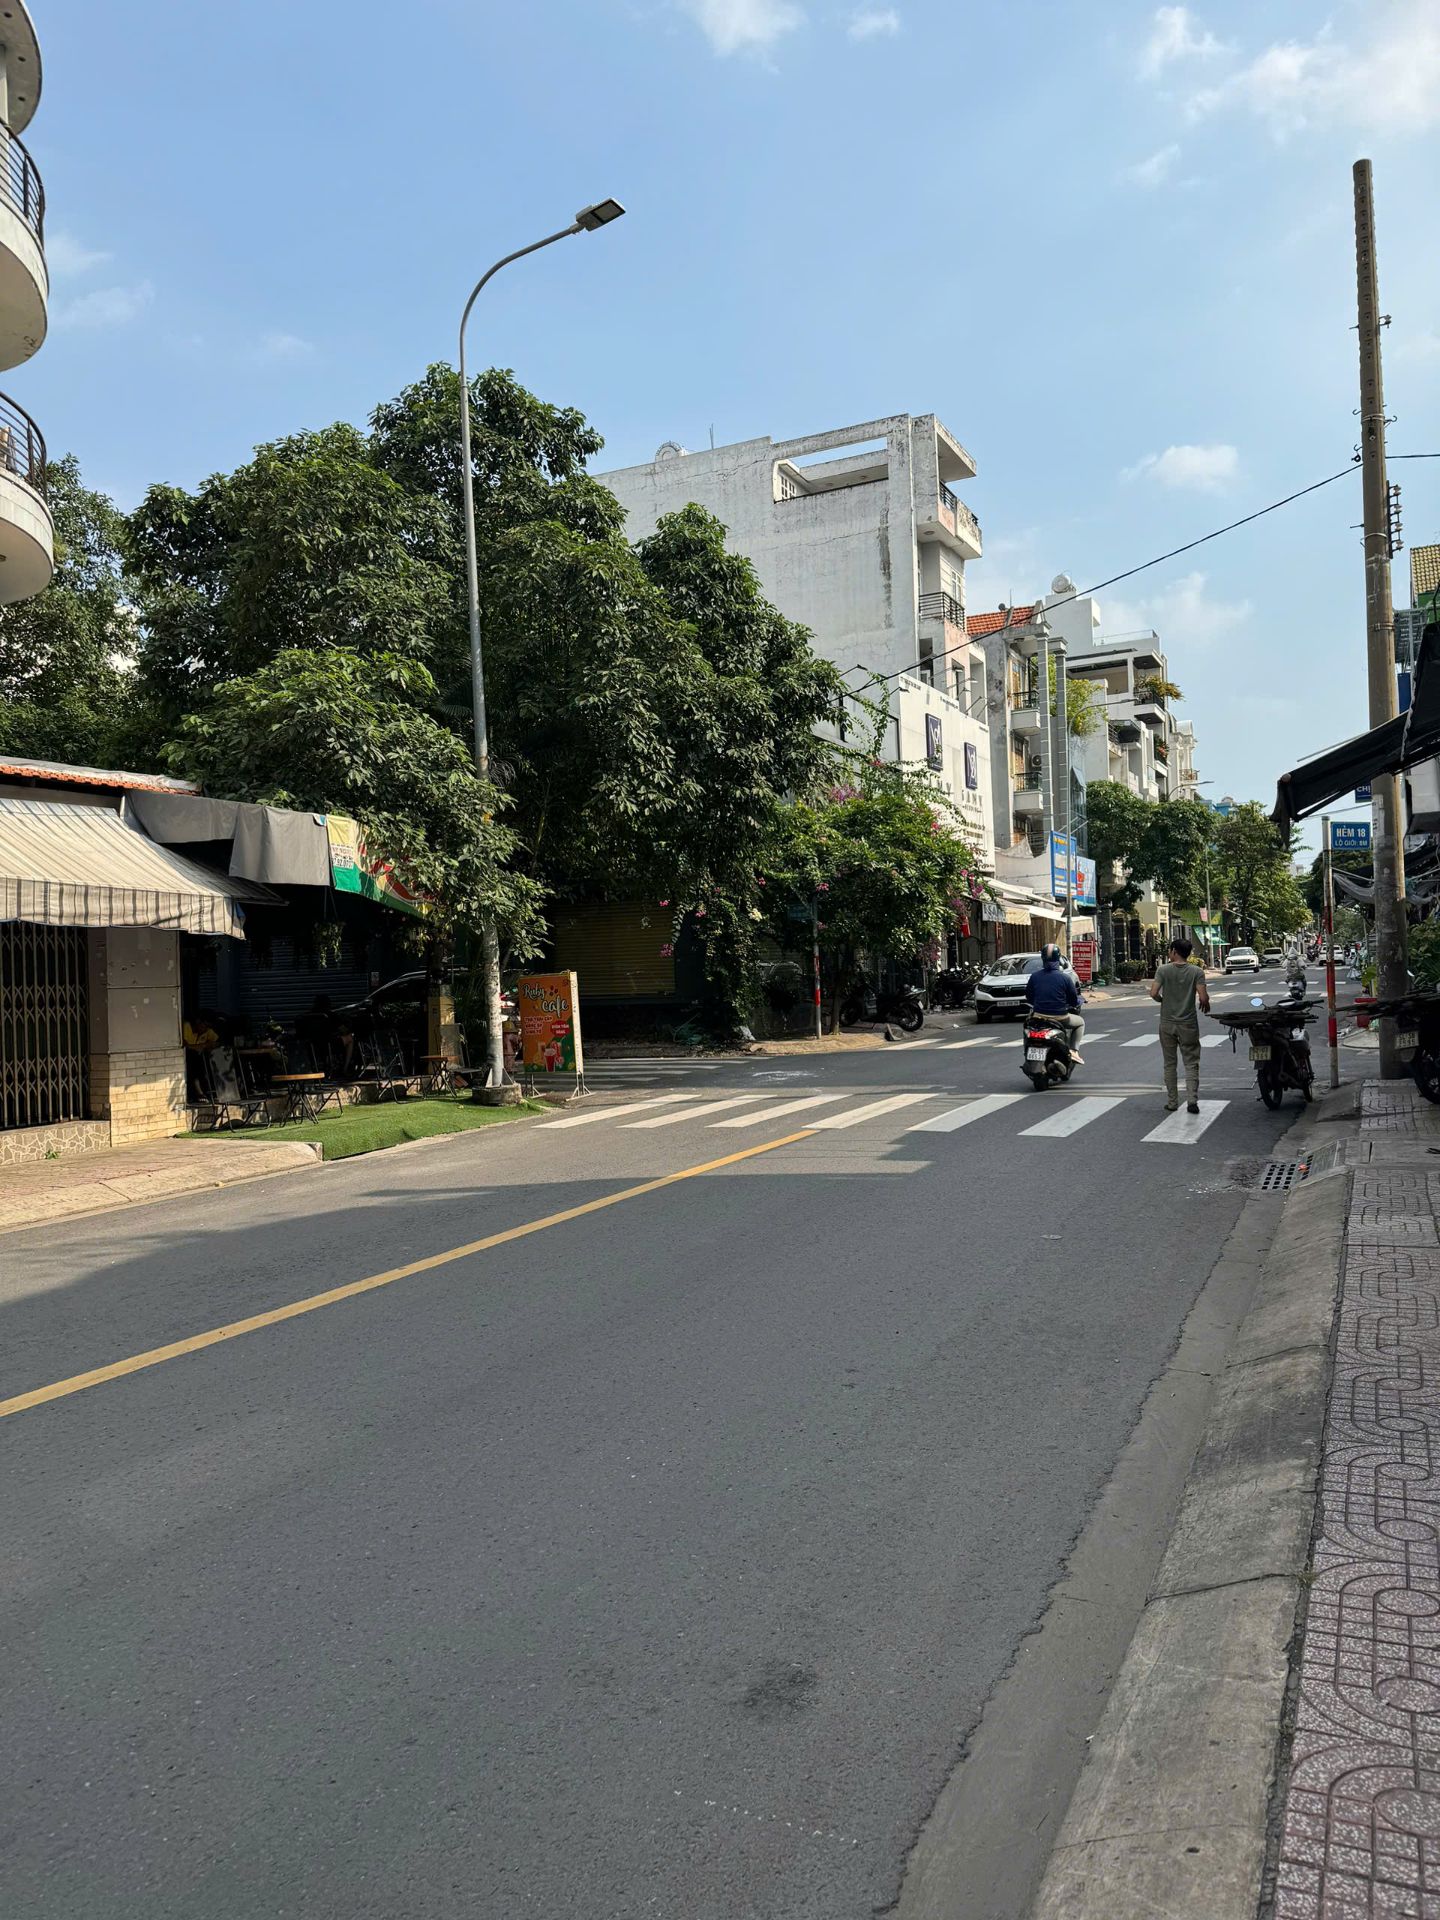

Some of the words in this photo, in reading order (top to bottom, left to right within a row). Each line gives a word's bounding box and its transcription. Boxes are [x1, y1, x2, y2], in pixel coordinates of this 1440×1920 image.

[1336, 825, 1355, 838] HẺM
[1357, 828, 1366, 838] 18
[523, 983, 545, 999] Ruby
[542, 995, 568, 1017] cafe
